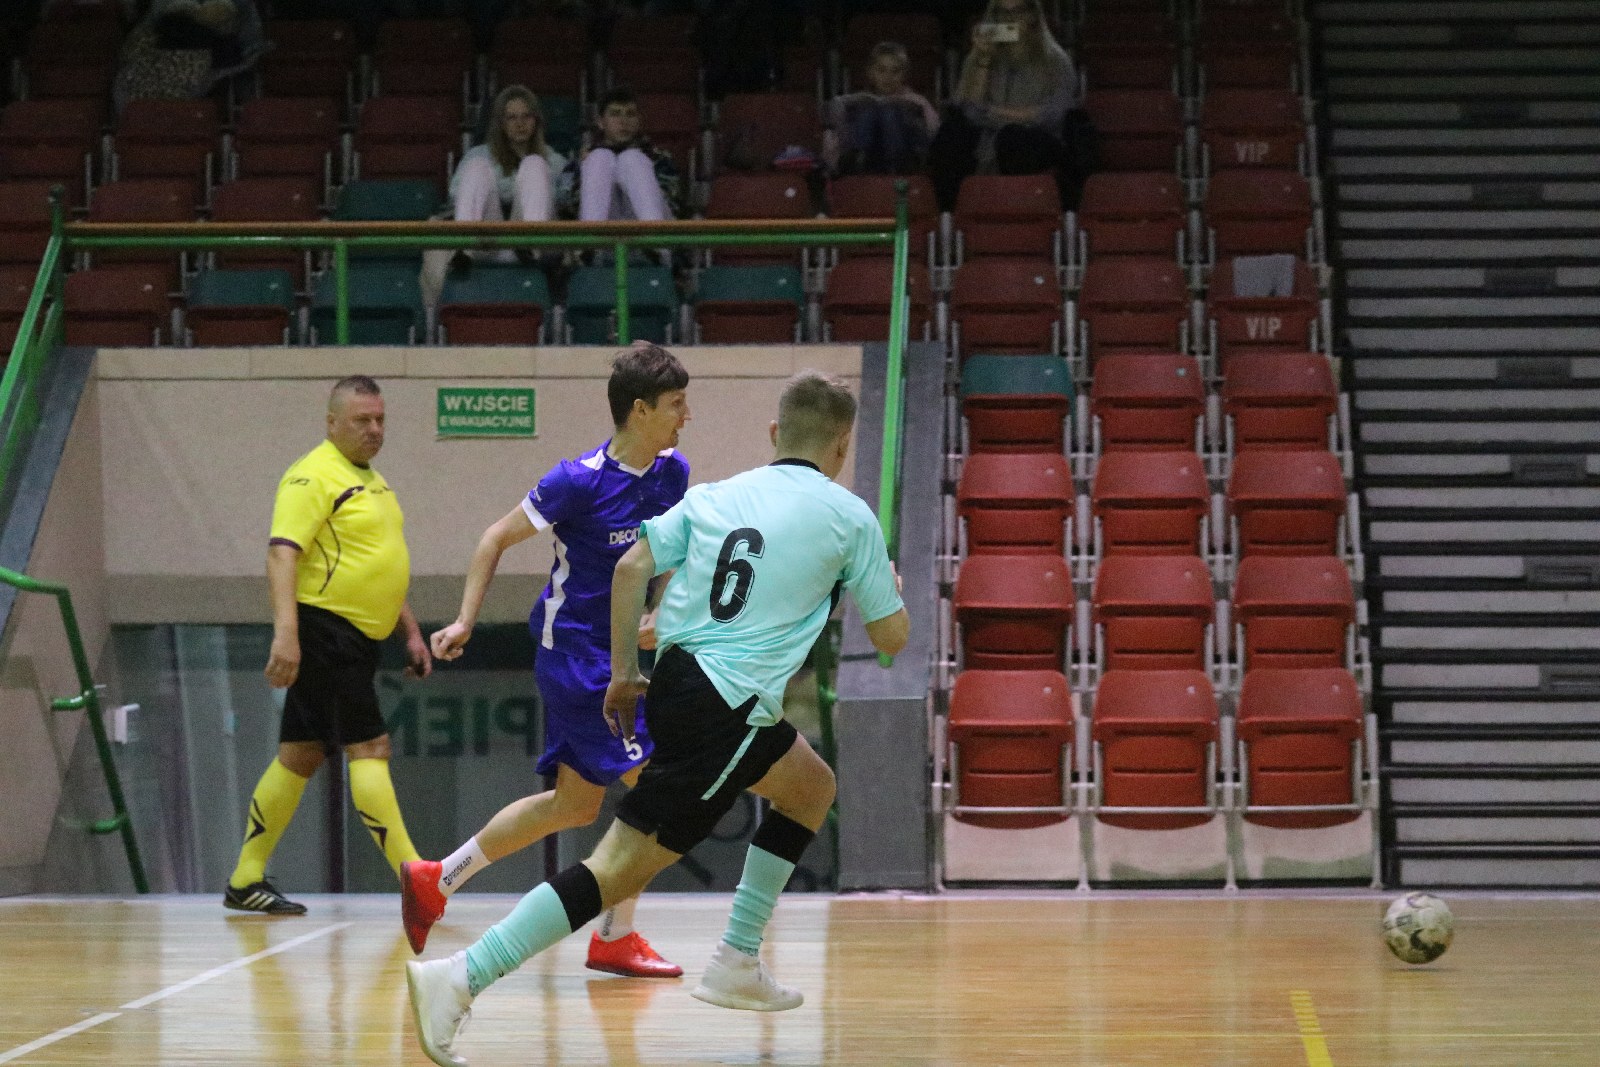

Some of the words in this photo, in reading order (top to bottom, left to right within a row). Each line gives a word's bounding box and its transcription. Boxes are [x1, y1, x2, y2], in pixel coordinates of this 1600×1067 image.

[1235, 142, 1269, 162] VIP
[1246, 317, 1282, 339] VIP
[444, 391, 529, 412] WYJŚCIE
[709, 527, 766, 624] 6
[622, 735, 643, 761] 5
